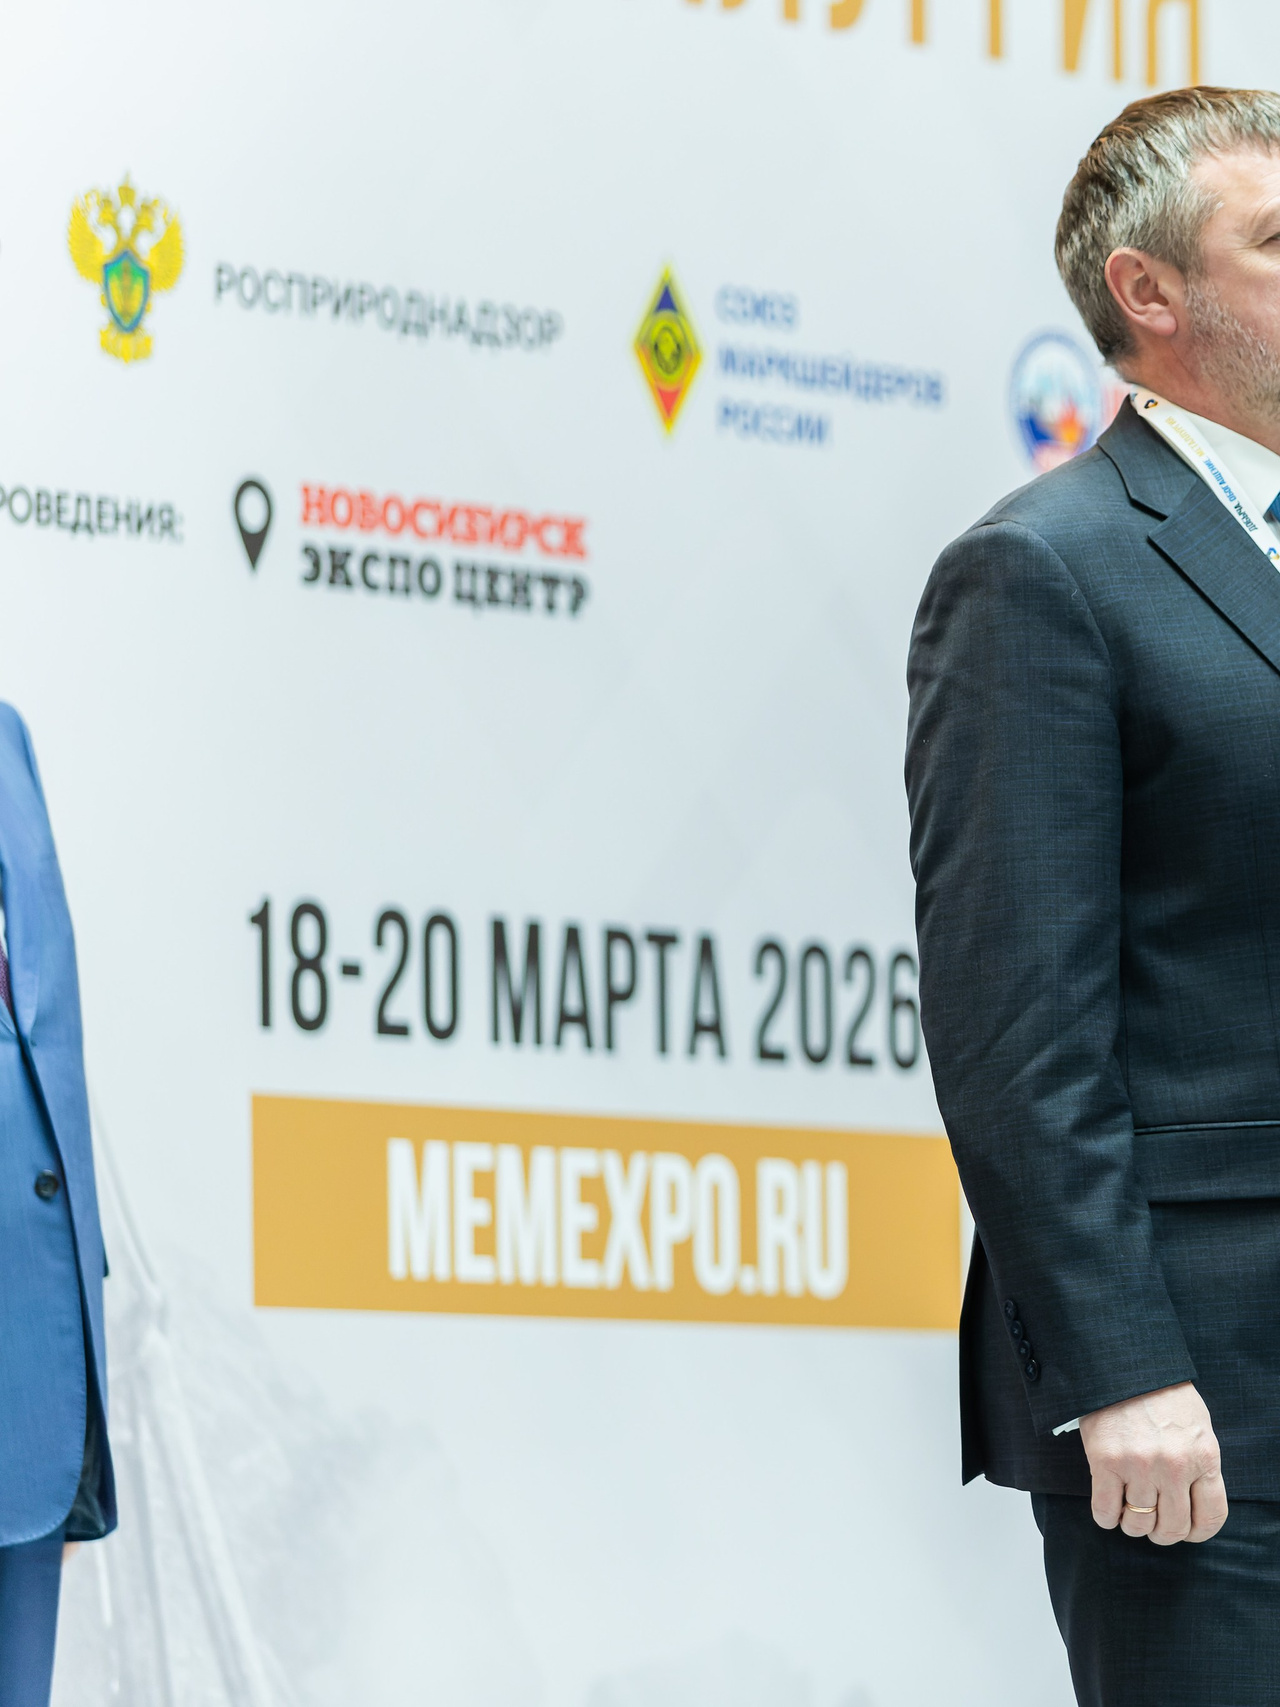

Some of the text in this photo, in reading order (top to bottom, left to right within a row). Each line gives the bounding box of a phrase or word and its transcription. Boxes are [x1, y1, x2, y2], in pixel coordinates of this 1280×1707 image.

[215, 263, 565, 353] РОСПРИРОДНАДЗОР
[300, 483, 589, 559] НОВОСИБИРСК
[302, 545, 589, 620] ЭКСПО ЦЕНТР
[250, 895, 919, 1071] 18-20 МАРТА 2026
[387, 1136, 848, 1300] MEMEXPO.RU
